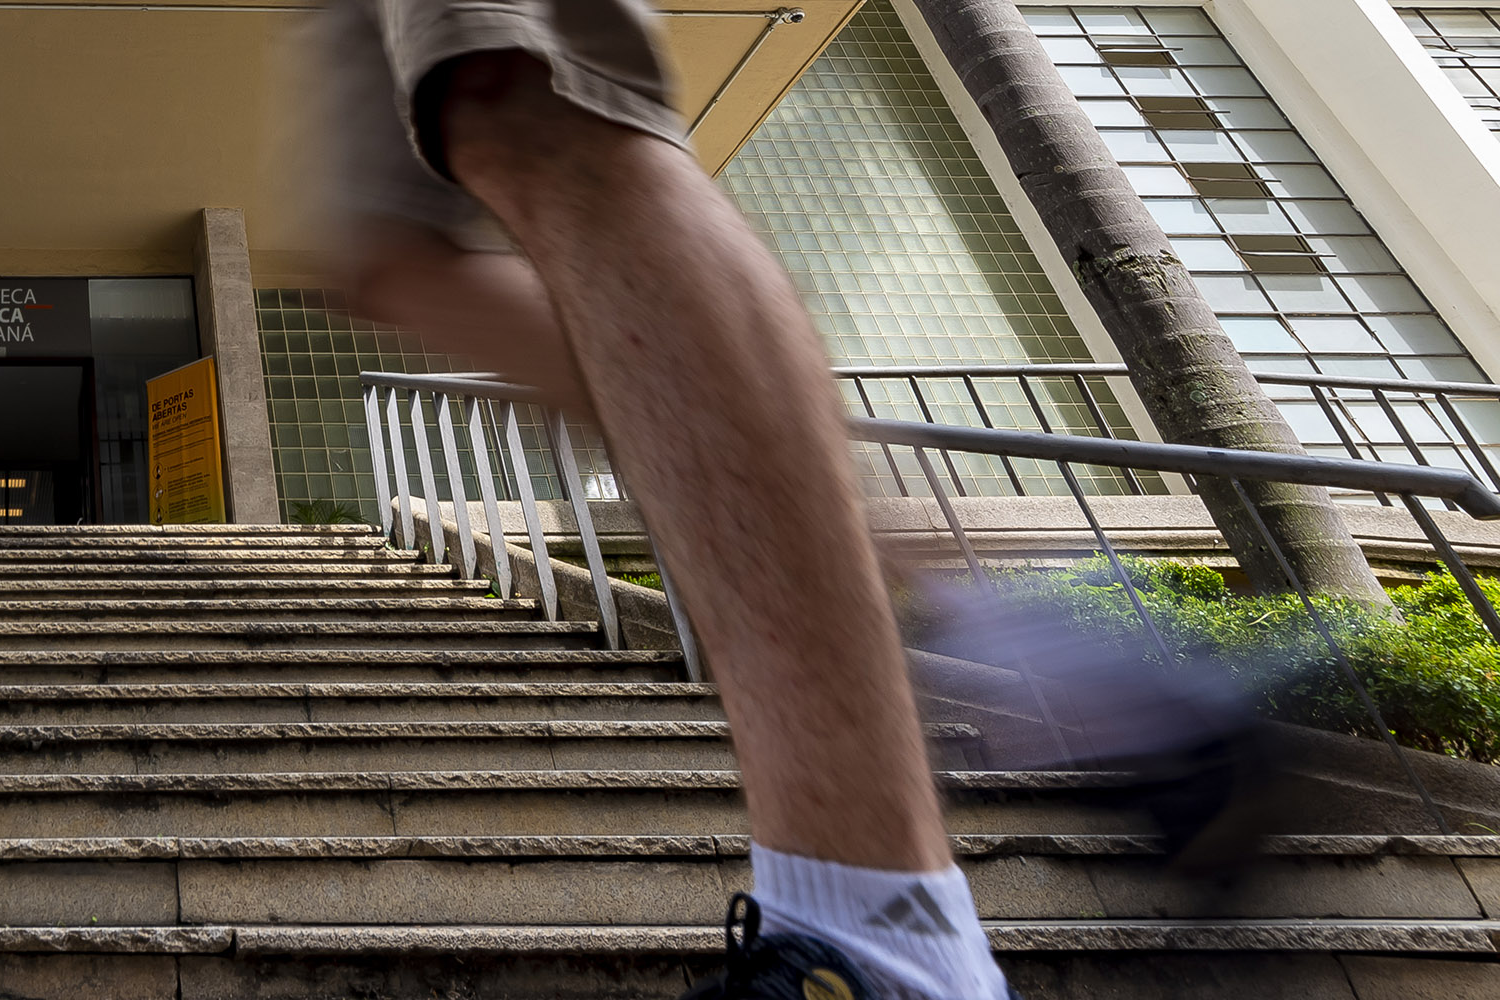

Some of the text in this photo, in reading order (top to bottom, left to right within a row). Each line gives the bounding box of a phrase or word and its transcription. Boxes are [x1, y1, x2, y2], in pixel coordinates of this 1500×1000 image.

[151, 388, 194, 413] DE PORTAS
[152, 401, 187, 422] ABERTAS
